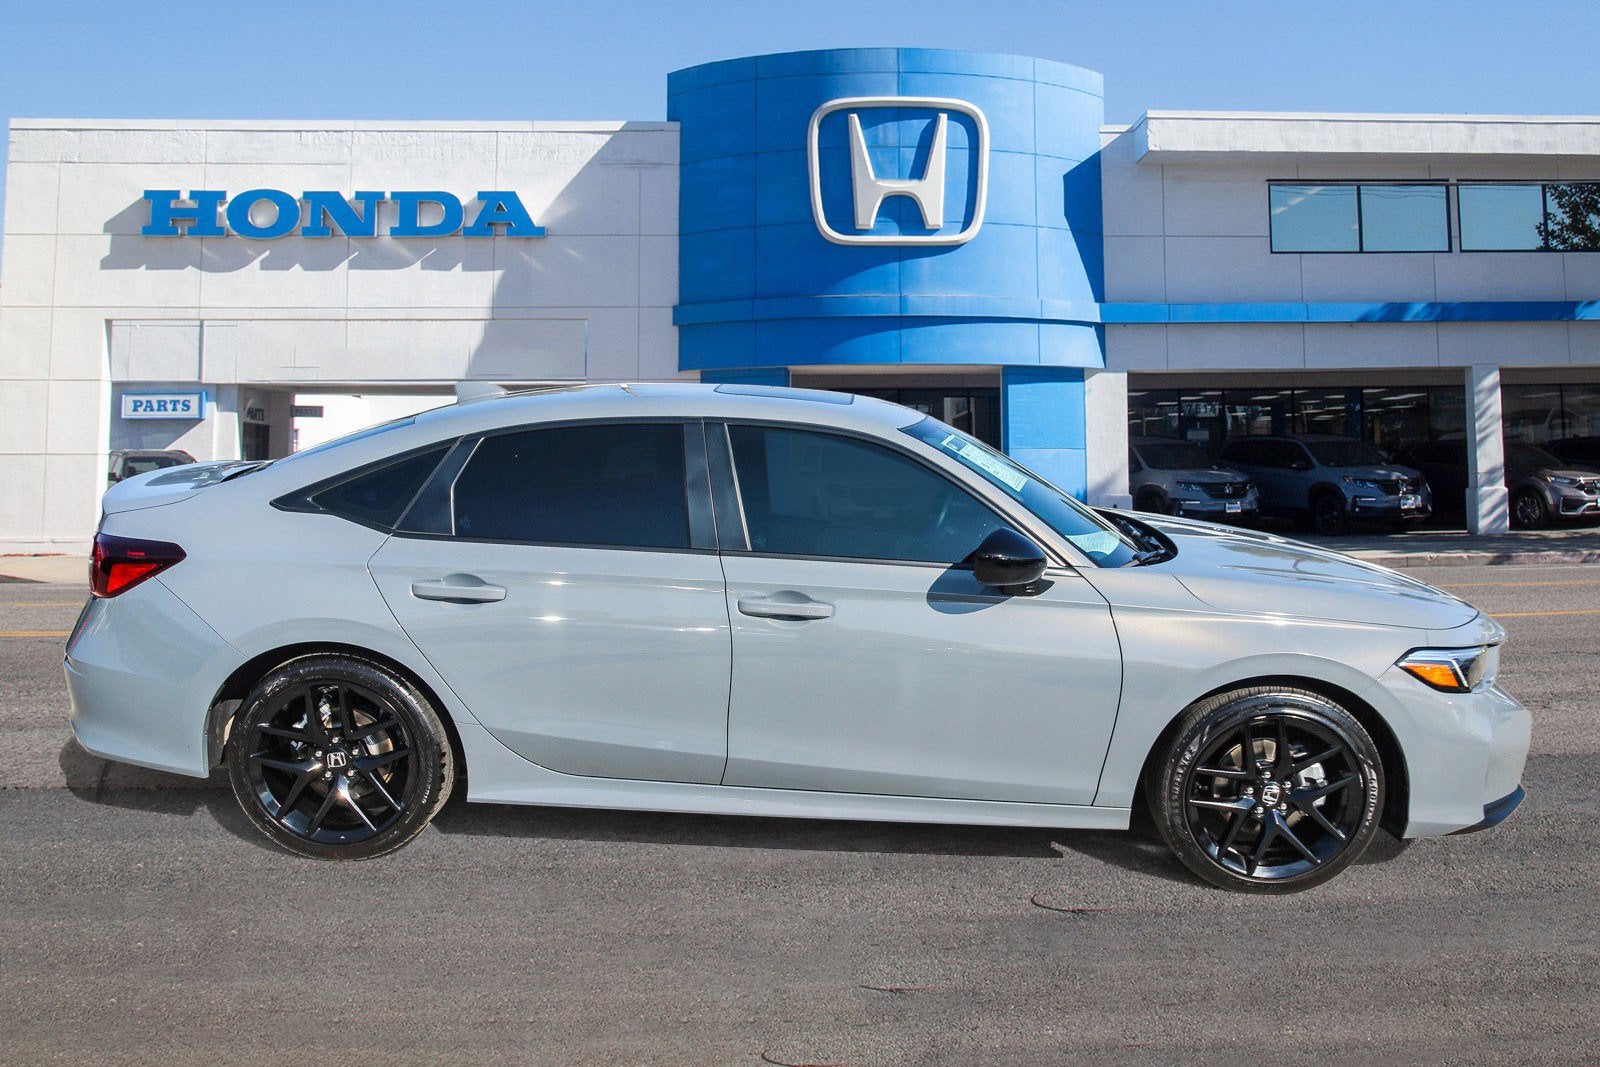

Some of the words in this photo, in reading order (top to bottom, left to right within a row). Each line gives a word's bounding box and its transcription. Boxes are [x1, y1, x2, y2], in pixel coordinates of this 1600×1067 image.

[141, 188, 546, 240] HONDA
[131, 399, 191, 412] PARTS
[246, 407, 264, 421] PARTS
